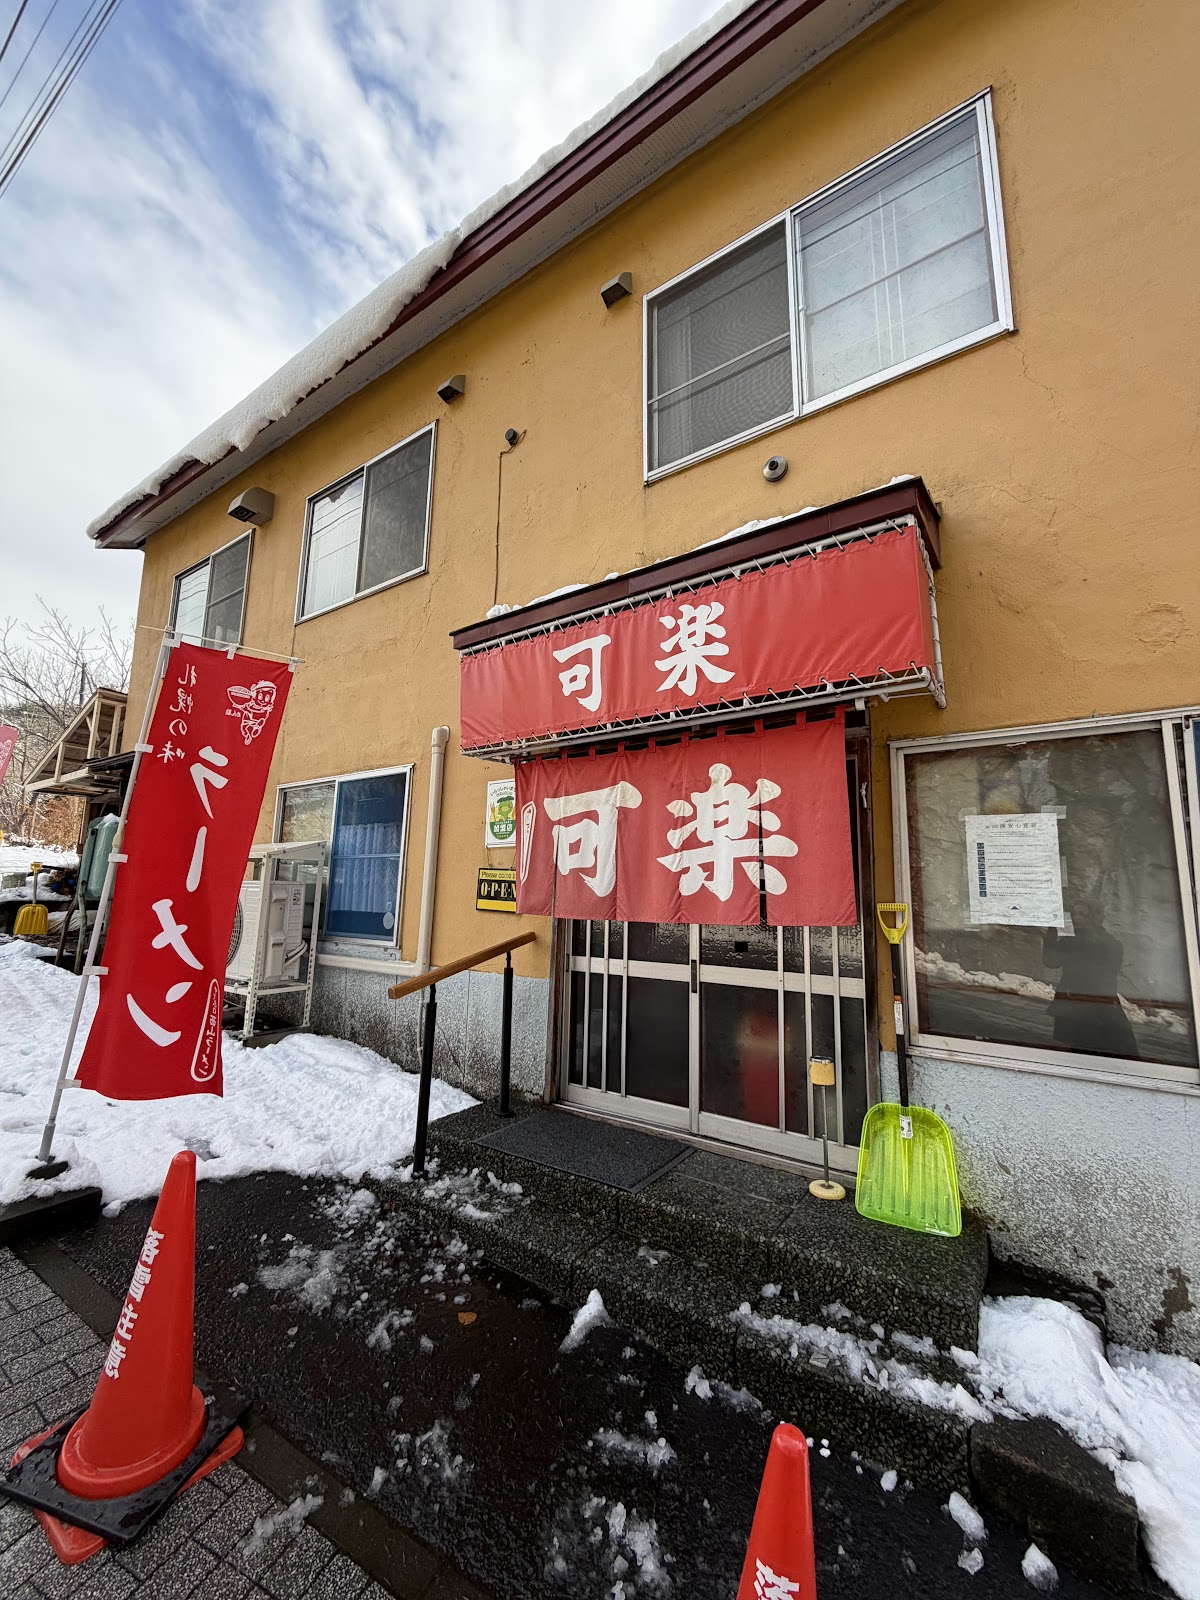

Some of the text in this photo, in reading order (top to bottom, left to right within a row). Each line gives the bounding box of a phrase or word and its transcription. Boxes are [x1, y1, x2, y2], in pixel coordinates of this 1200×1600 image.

[553, 601, 735, 712] 可楽
[490, 786, 516, 797] いらっしゃいま
[543, 763, 798, 901] 可楽
